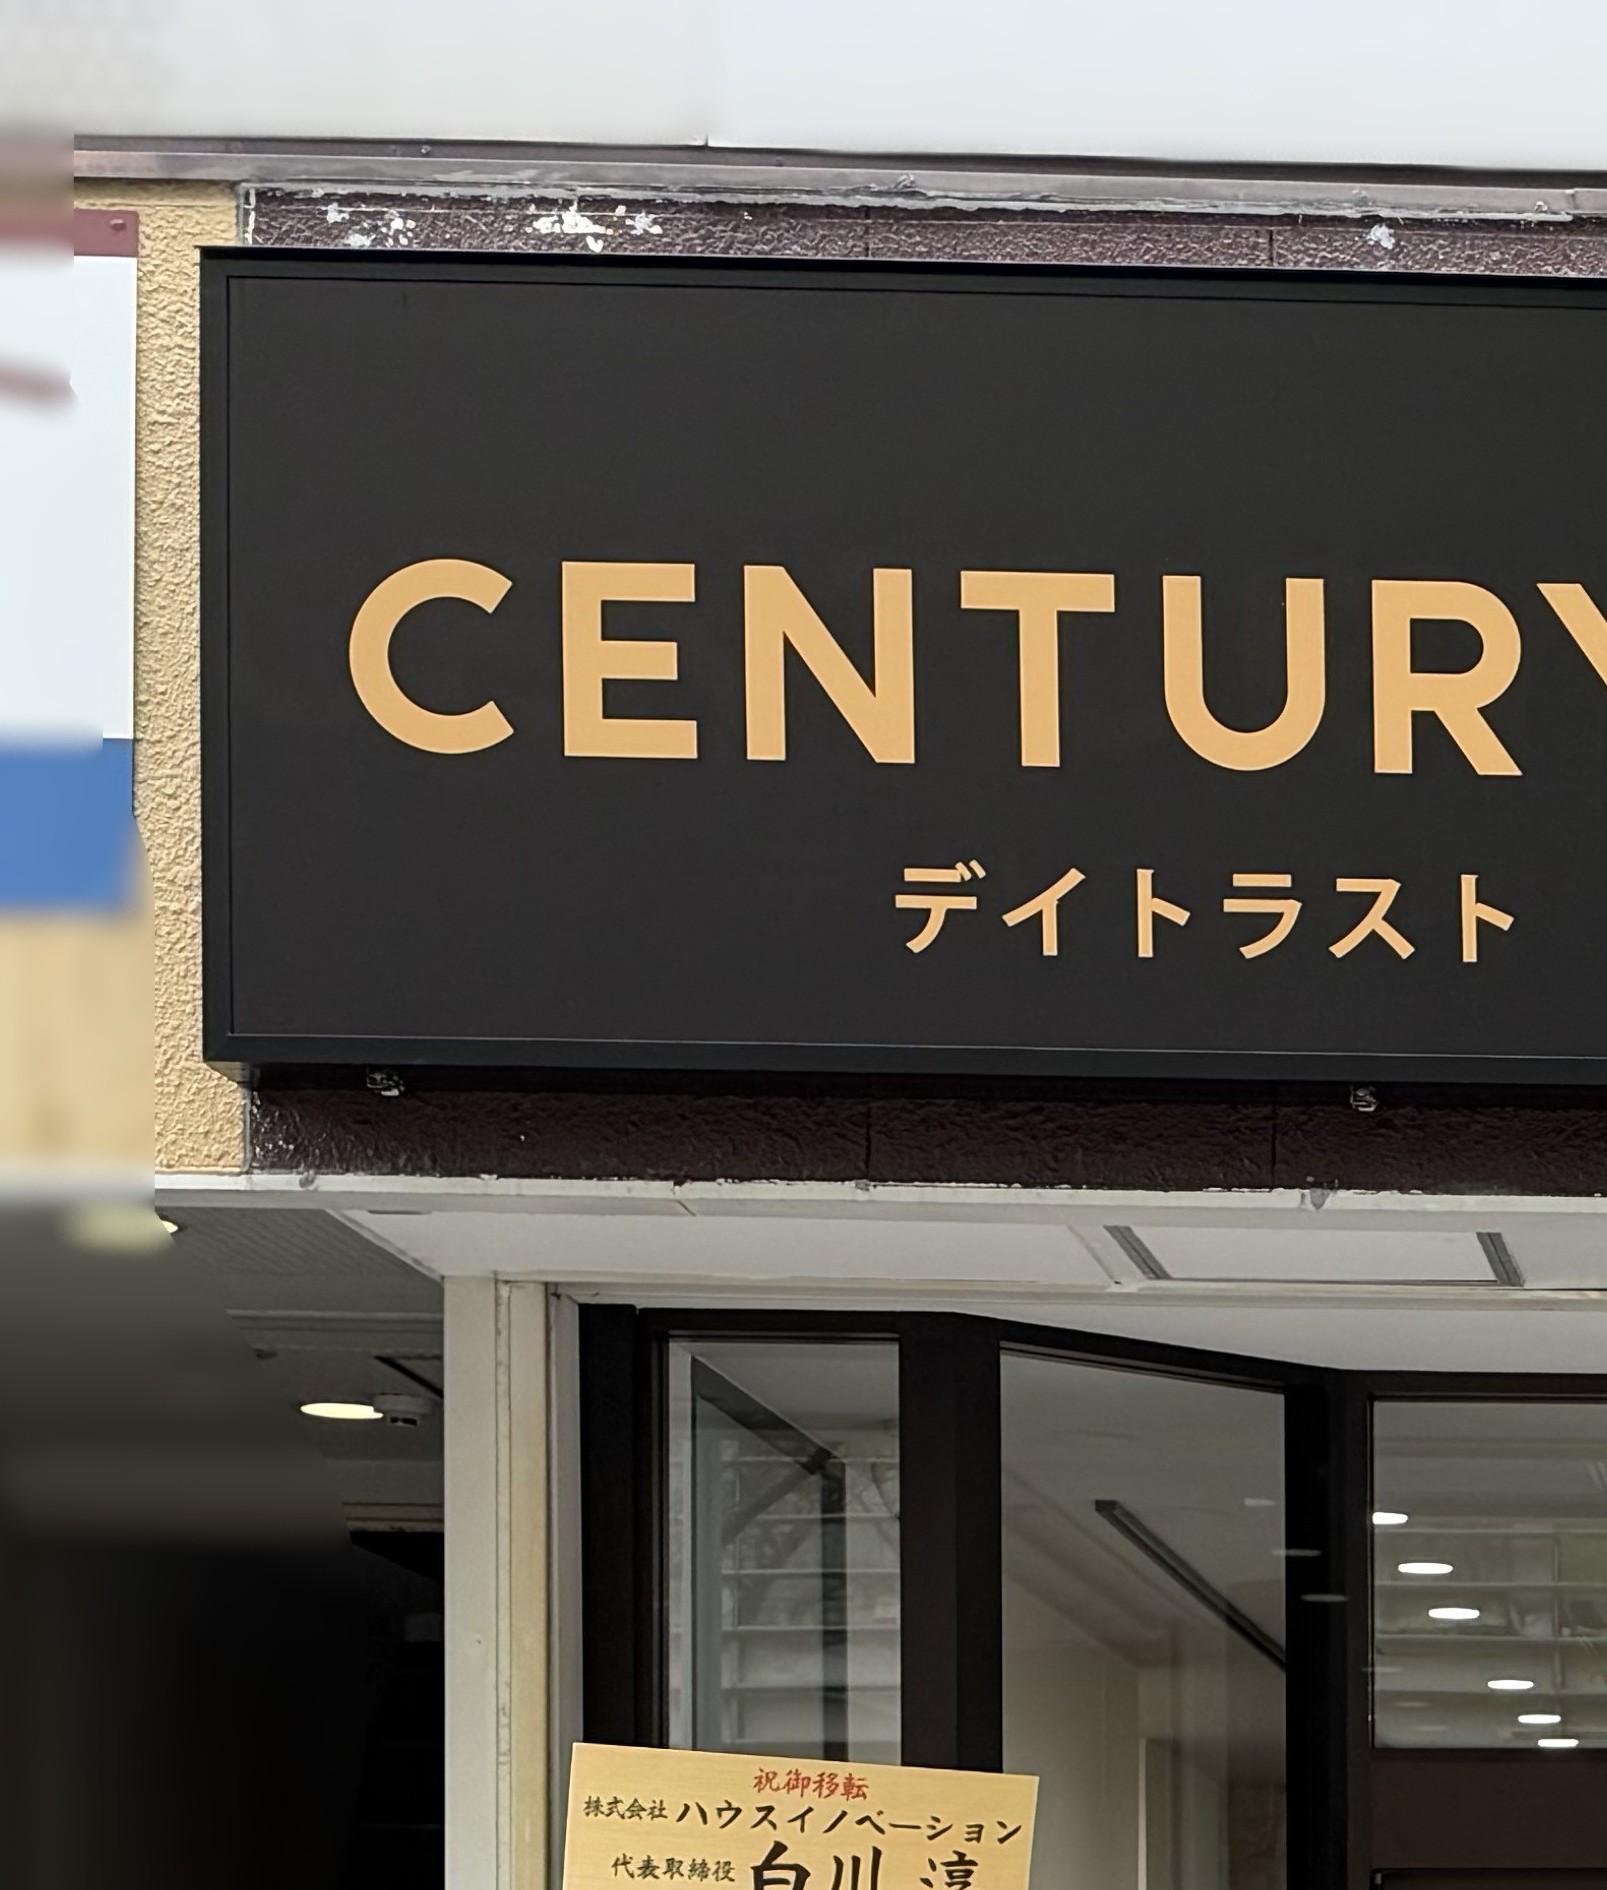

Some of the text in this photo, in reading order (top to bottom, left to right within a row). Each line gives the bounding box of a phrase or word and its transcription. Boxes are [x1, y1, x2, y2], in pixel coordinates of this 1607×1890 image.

[896, 860, 1515, 964] デイトラスト
[753, 1767, 869, 1801] 祝御移転
[583, 1795, 1023, 1845] 株式会社 ハウスイノベーション
[611, 1854, 736, 1884] 代表取締役
